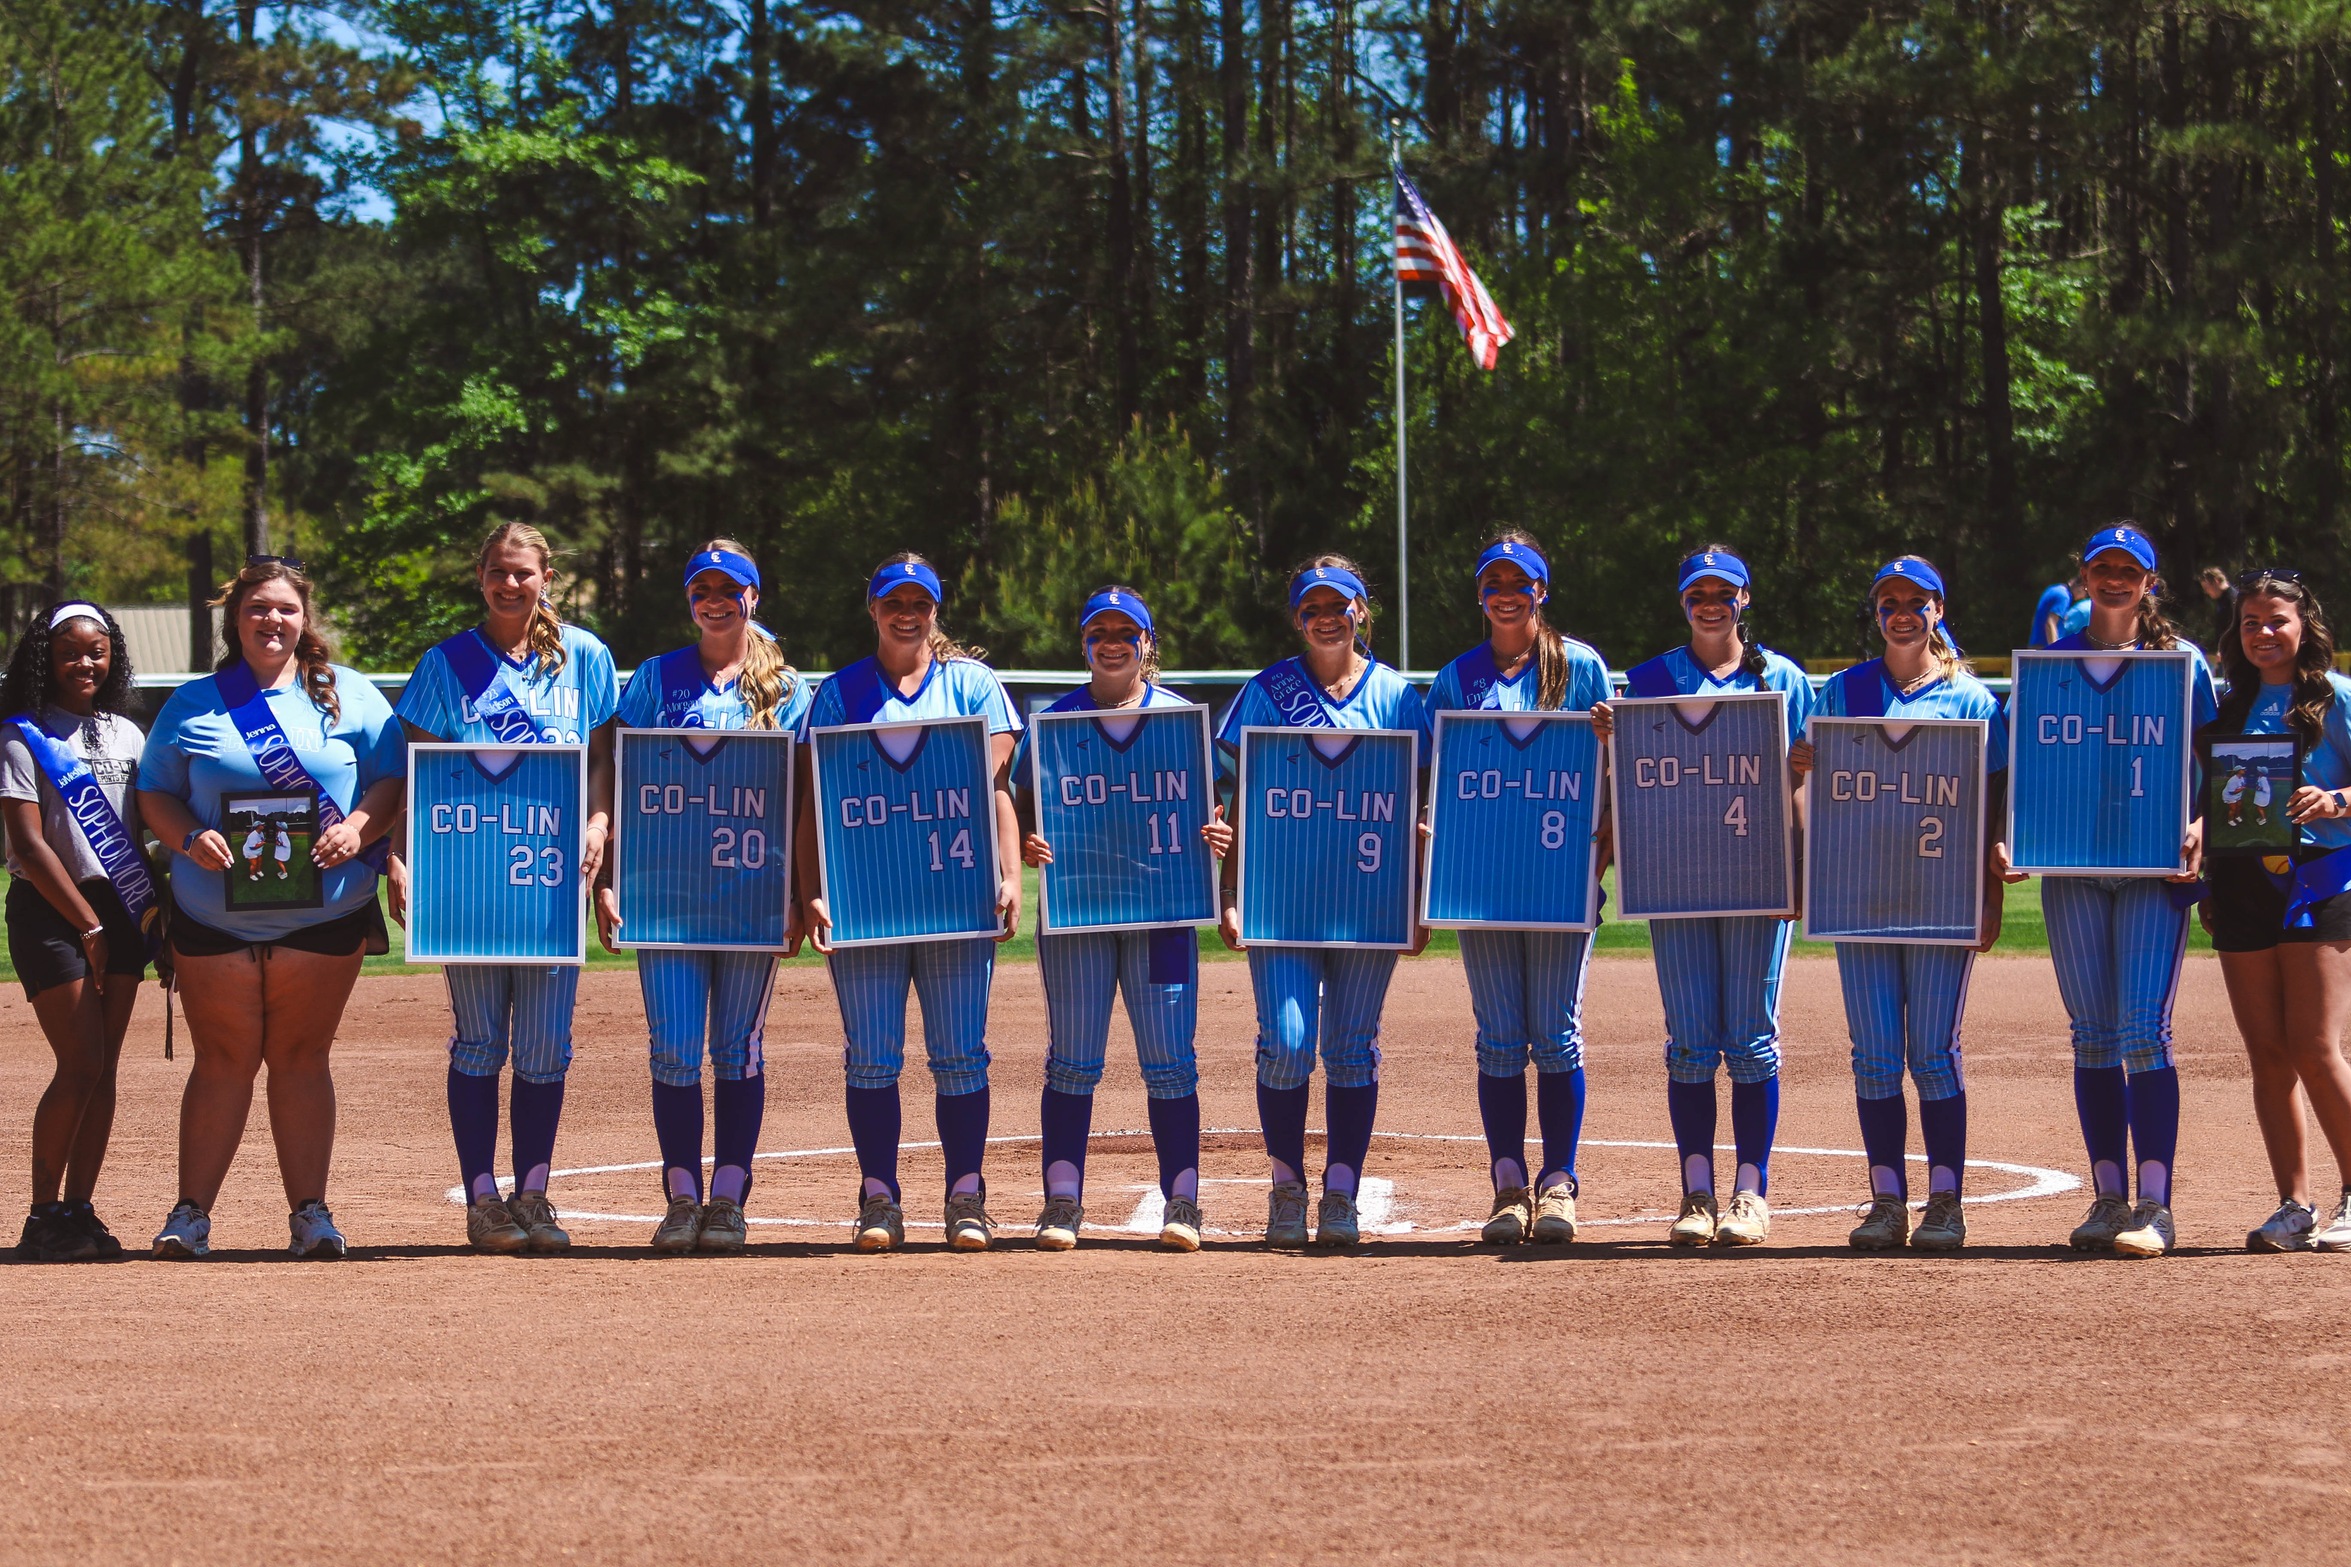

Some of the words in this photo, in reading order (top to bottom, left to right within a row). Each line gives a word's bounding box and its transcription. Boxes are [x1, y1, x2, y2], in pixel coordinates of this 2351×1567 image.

[672, 688, 691, 700] #20
[1271, 674, 1296, 693] Anna
[1273, 680, 1301, 701] Grace
[1473, 677, 1487, 688] #8
[461, 685, 581, 724] C-LIN
[245, 723, 276, 741] Jenna
[2038, 714, 2165, 746] CO-LIN
[1060, 769, 1188, 806] CO-LIN
[1457, 768, 1582, 801] CO-LIN
[1635, 754, 1762, 788] CO-LIN
[1831, 769, 1960, 807] CO-LIN
[2130, 756, 2144, 797] 1
[431, 803, 561, 836] CO-LIN
[639, 783, 766, 819] CO-LIN
[840, 787, 970, 828] CO-LIN
[1265, 786, 1396, 823] CO-LIN
[1723, 795, 1748, 837] 4
[711, 826, 766, 870] 20
[1148, 811, 1182, 855] 11
[1540, 810, 1566, 850] 8
[1918, 815, 1943, 859] 2
[68, 785, 155, 914] SOPHOMORE
[508, 844, 565, 888] 23
[927, 828, 975, 872] 14
[1356, 832, 1382, 874] 9
